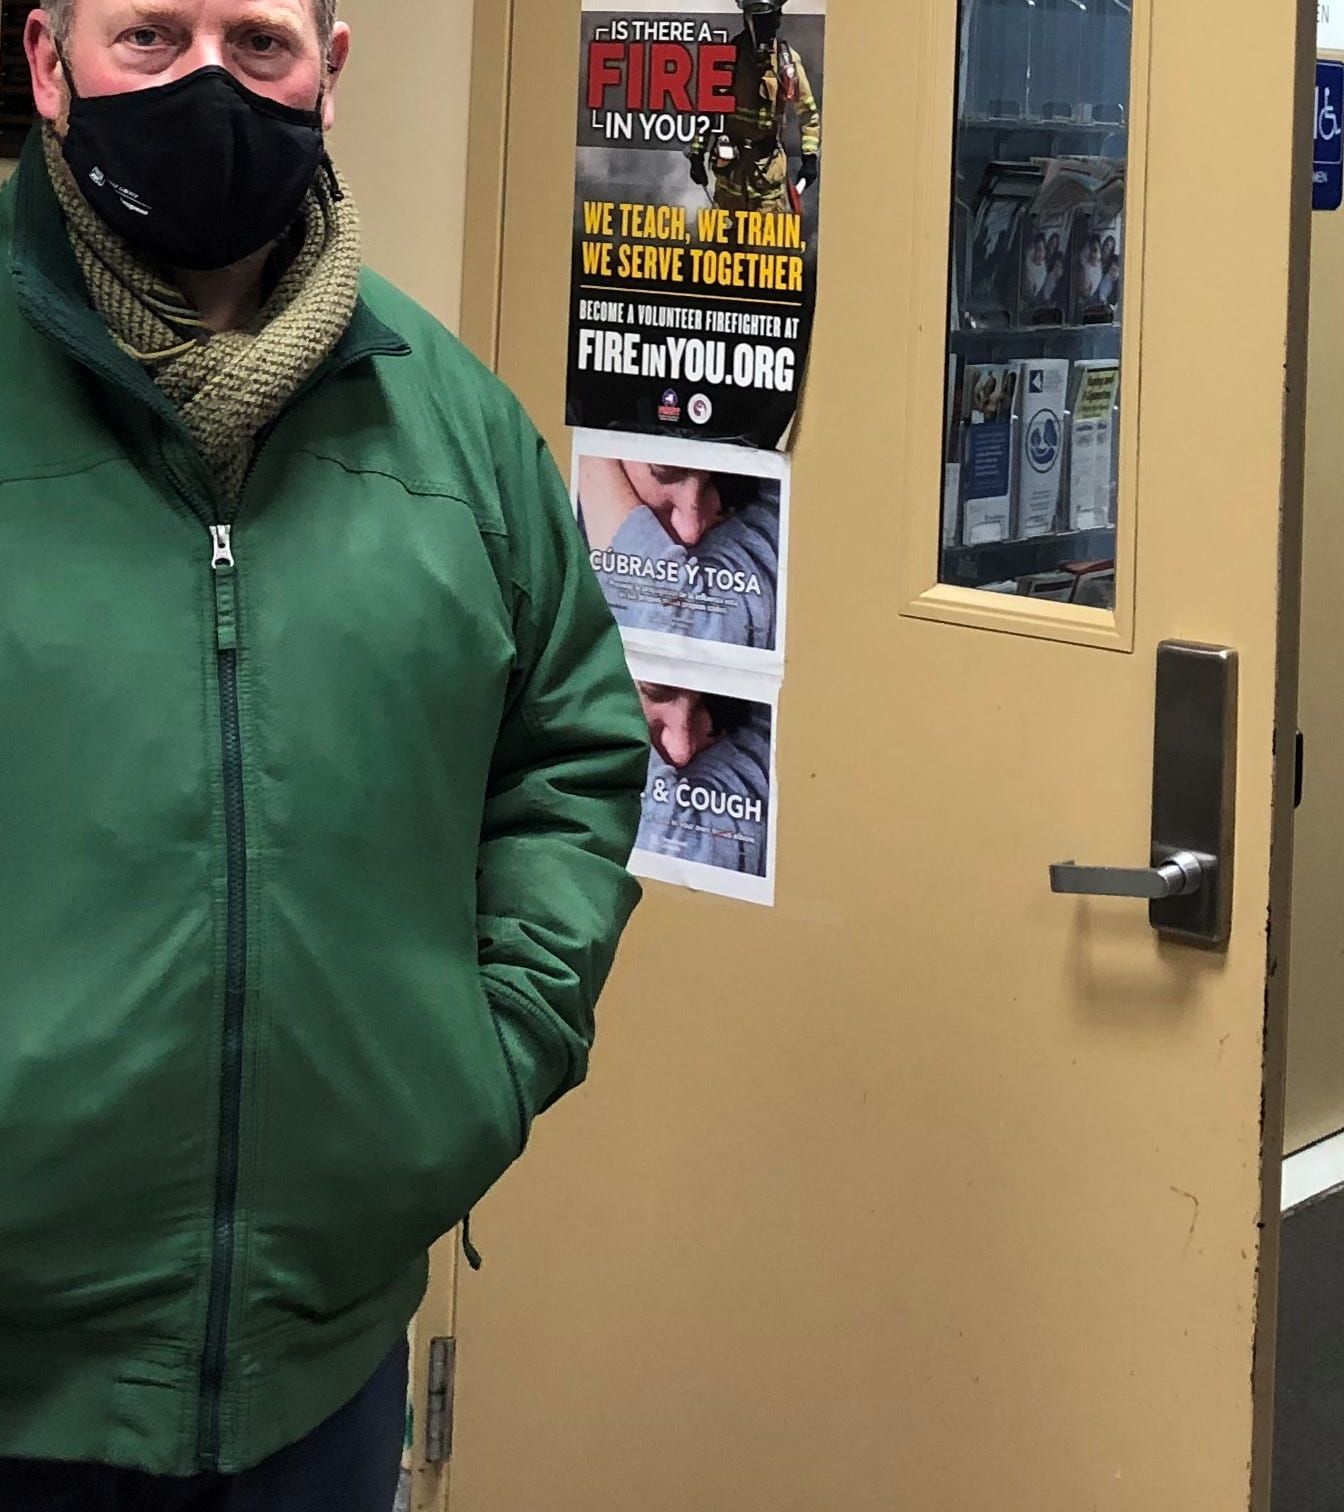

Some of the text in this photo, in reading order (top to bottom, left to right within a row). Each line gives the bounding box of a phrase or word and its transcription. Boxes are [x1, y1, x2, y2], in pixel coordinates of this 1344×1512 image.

[610, 21, 713, 42] IS THERE A
[587, 41, 737, 114] FIRE
[604, 113, 709, 144] IN YOU?
[583, 201, 806, 252] WE TEACH, WE TRAIN,
[582, 241, 803, 292] WE SERVE TOGETHER
[579, 299, 800, 339] BECOME A VOLUNTEER FIREFIGHTER AT
[589, 546, 679, 582] CÚBRASE
[705, 567, 762, 595] TOSA
[653, 778, 762, 822] & COUGH
